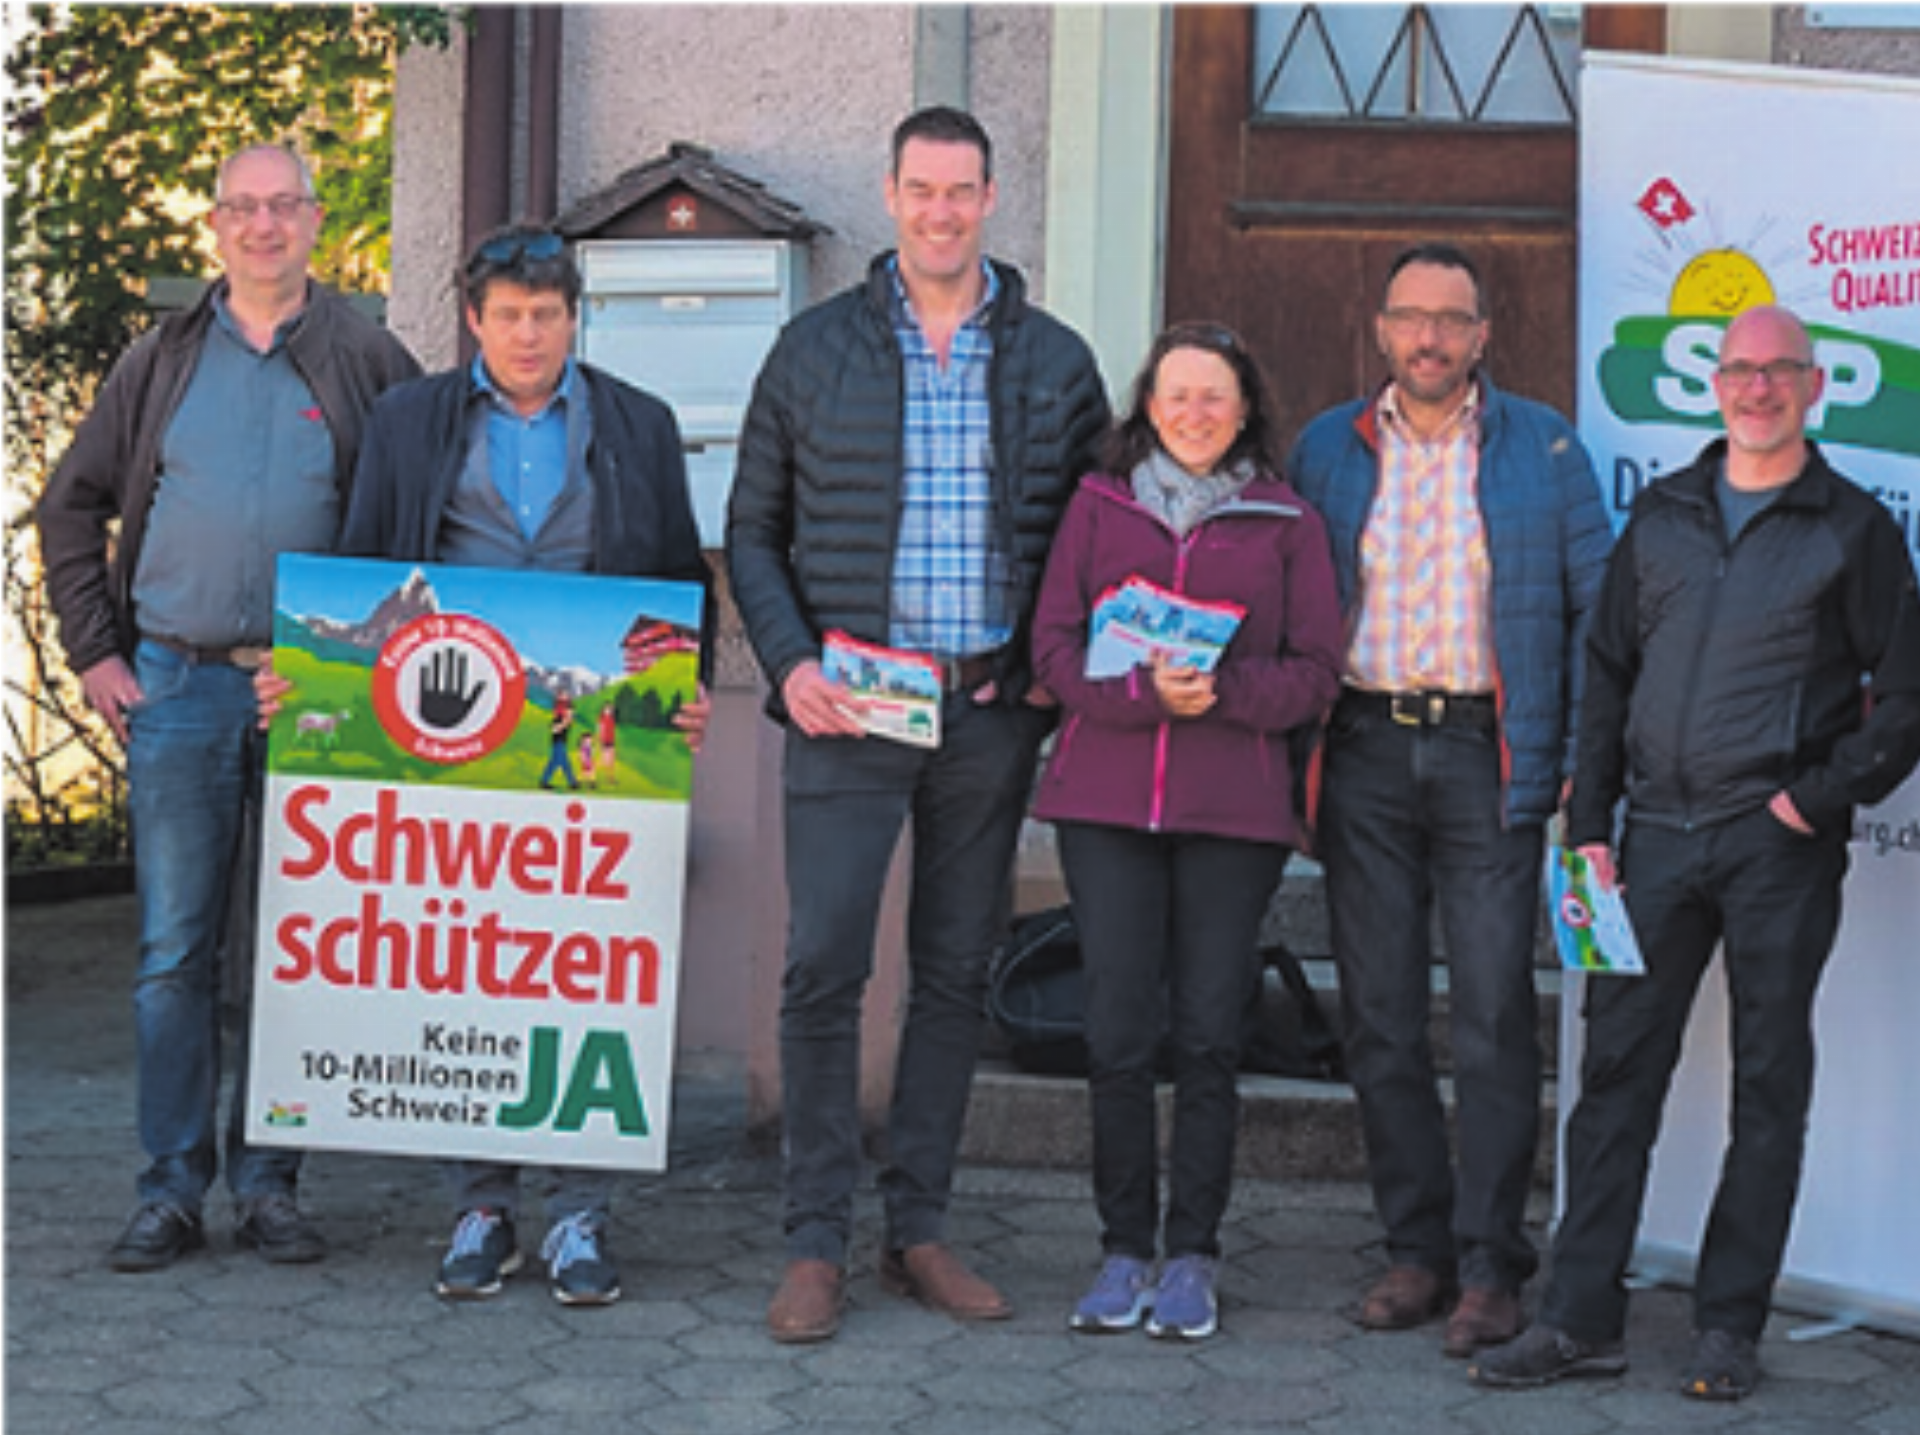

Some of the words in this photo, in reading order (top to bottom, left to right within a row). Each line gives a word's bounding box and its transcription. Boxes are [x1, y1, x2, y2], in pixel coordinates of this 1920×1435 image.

[1655, 323, 1881, 430] SP
[281, 785, 631, 899] Schweiz
[273, 893, 659, 1006] schützen
[302, 1051, 517, 1090] 10-Millionen
[423, 1023, 521, 1058] Keine
[496, 1026, 649, 1136] JA
[348, 1087, 488, 1125] Schweiz
